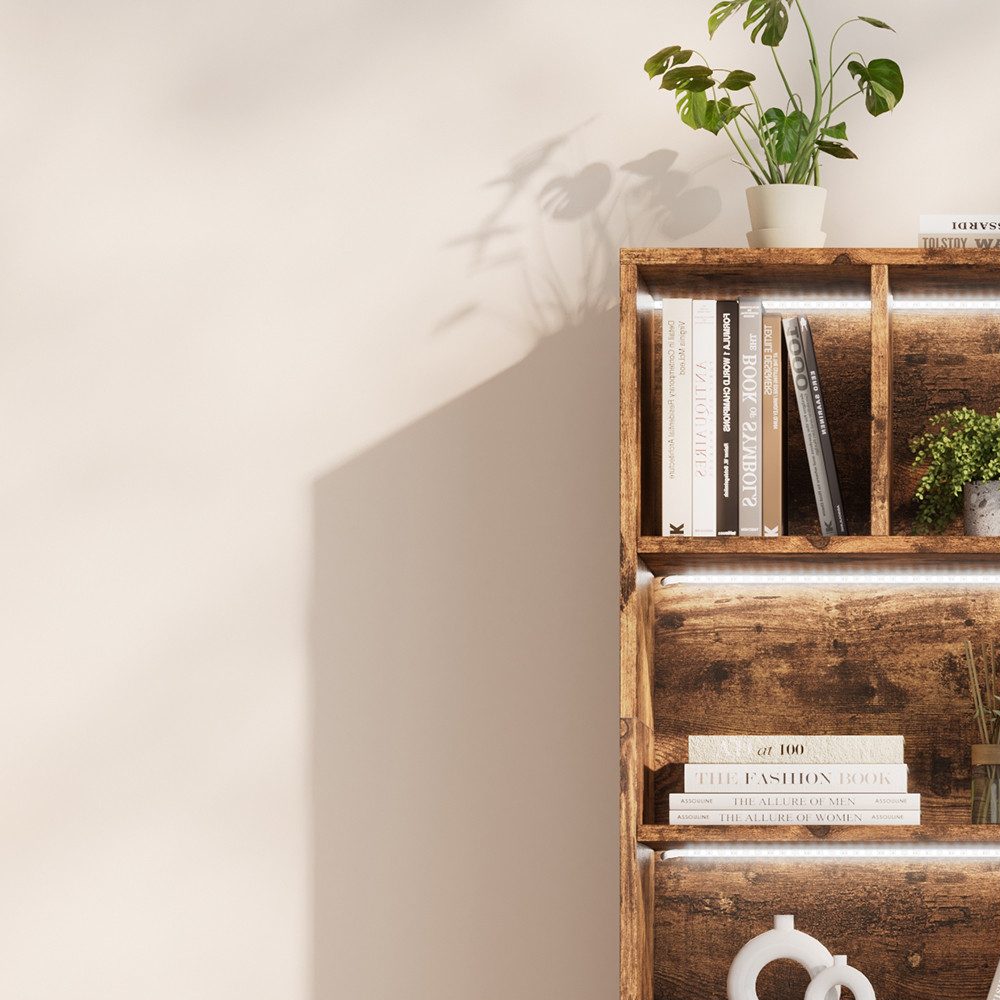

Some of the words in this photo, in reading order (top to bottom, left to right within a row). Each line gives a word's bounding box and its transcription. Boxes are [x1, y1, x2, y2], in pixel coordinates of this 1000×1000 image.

[922, 237, 968, 248] TOLSTOY
[757, 744, 772, 756] at
[780, 744, 804, 756] 100
[694, 772, 738, 785] THE
[744, 772, 832, 785] FASHION
[839, 772, 892, 785] BOOK
[733, 797, 753, 806] THE
[759, 797, 807, 806] ALLURE
[810, 797, 826, 806] OF
[829, 797, 856, 806] MEN
[720, 813, 741, 822] THE
[745, 813, 794, 822] ALLURE
[796, 813, 812, 822] OF
[816, 813, 864, 822] WOMEN
